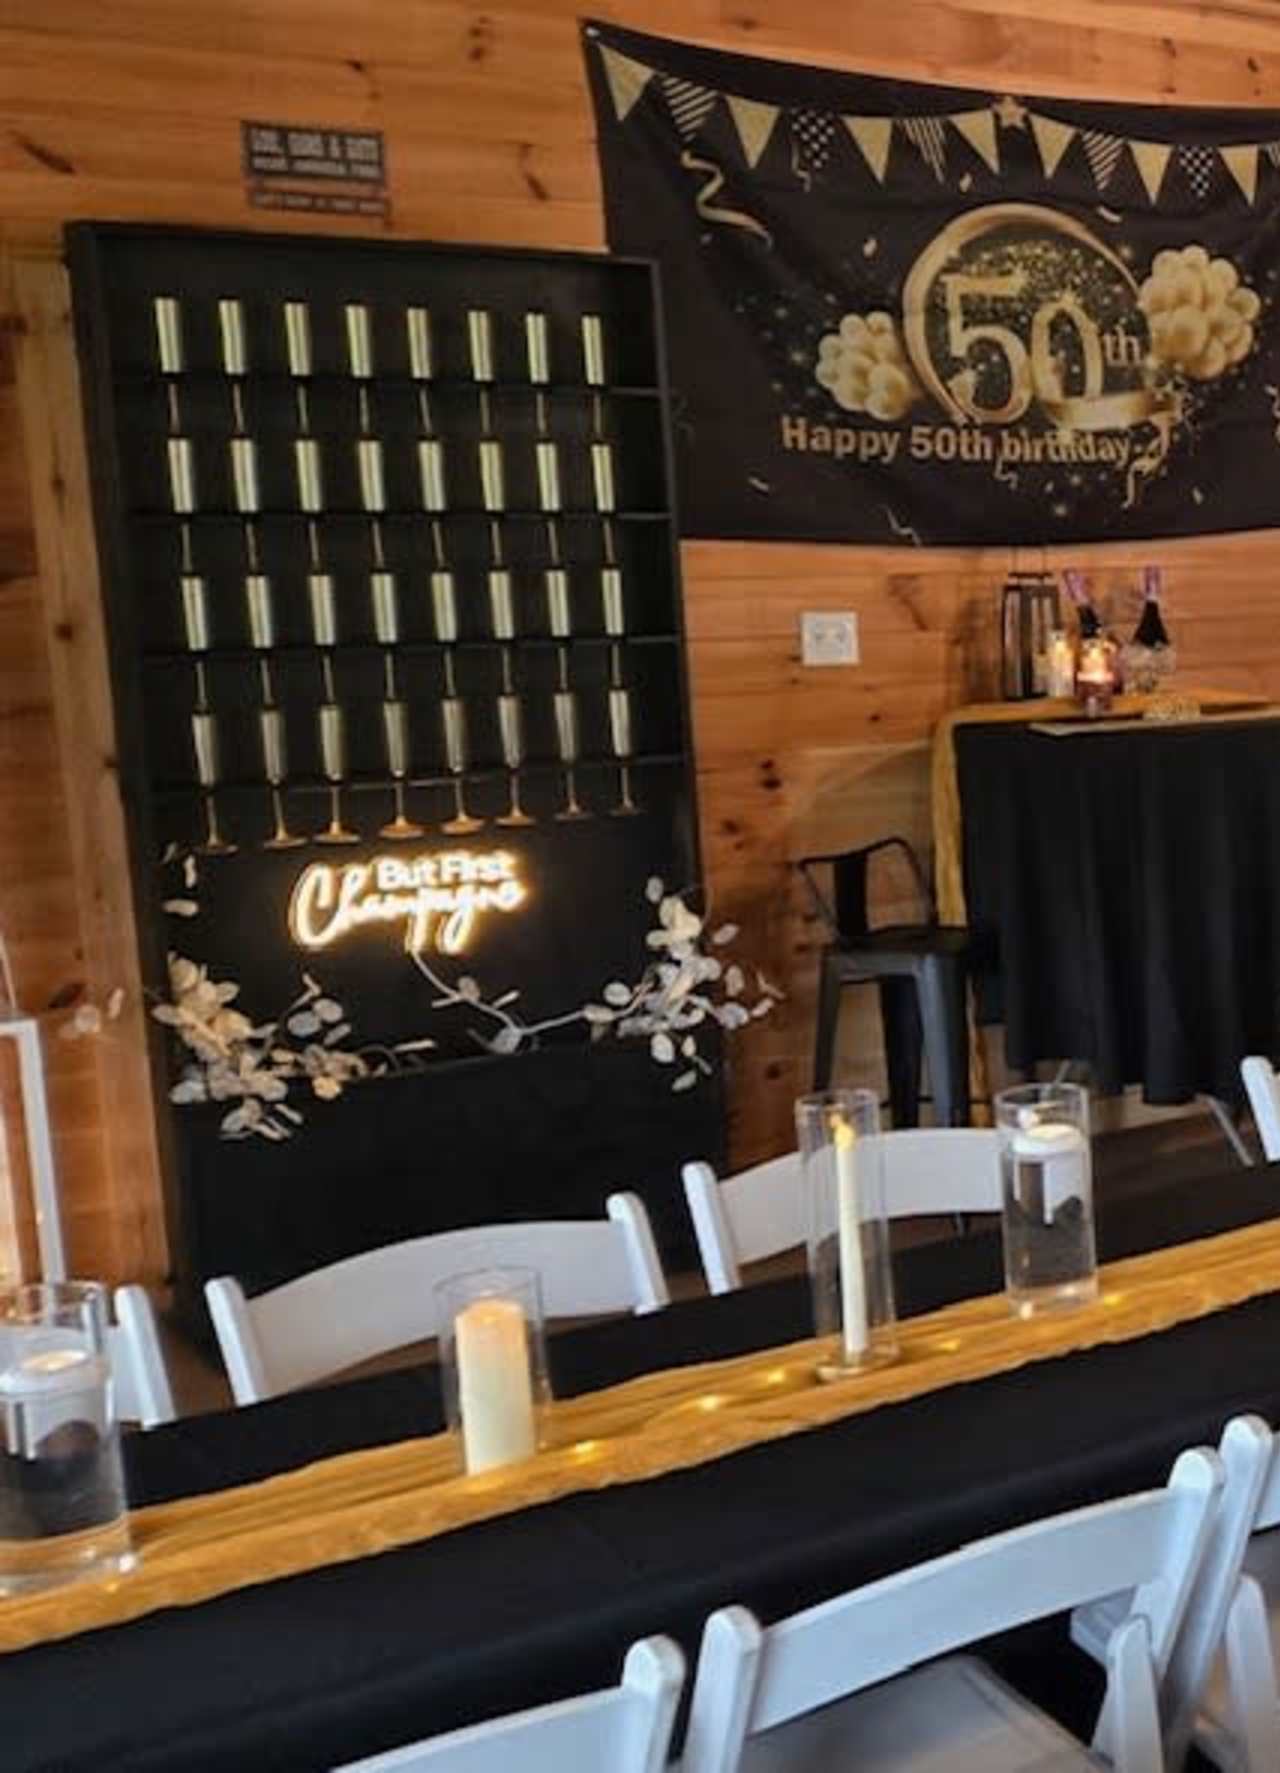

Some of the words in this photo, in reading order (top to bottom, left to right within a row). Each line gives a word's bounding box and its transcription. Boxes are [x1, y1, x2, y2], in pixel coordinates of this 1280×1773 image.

[781, 416, 900, 463] Happy
[911, 426, 993, 461] 50th
[1000, 430, 1131, 466] birthday
[377, 856, 439, 889] But
